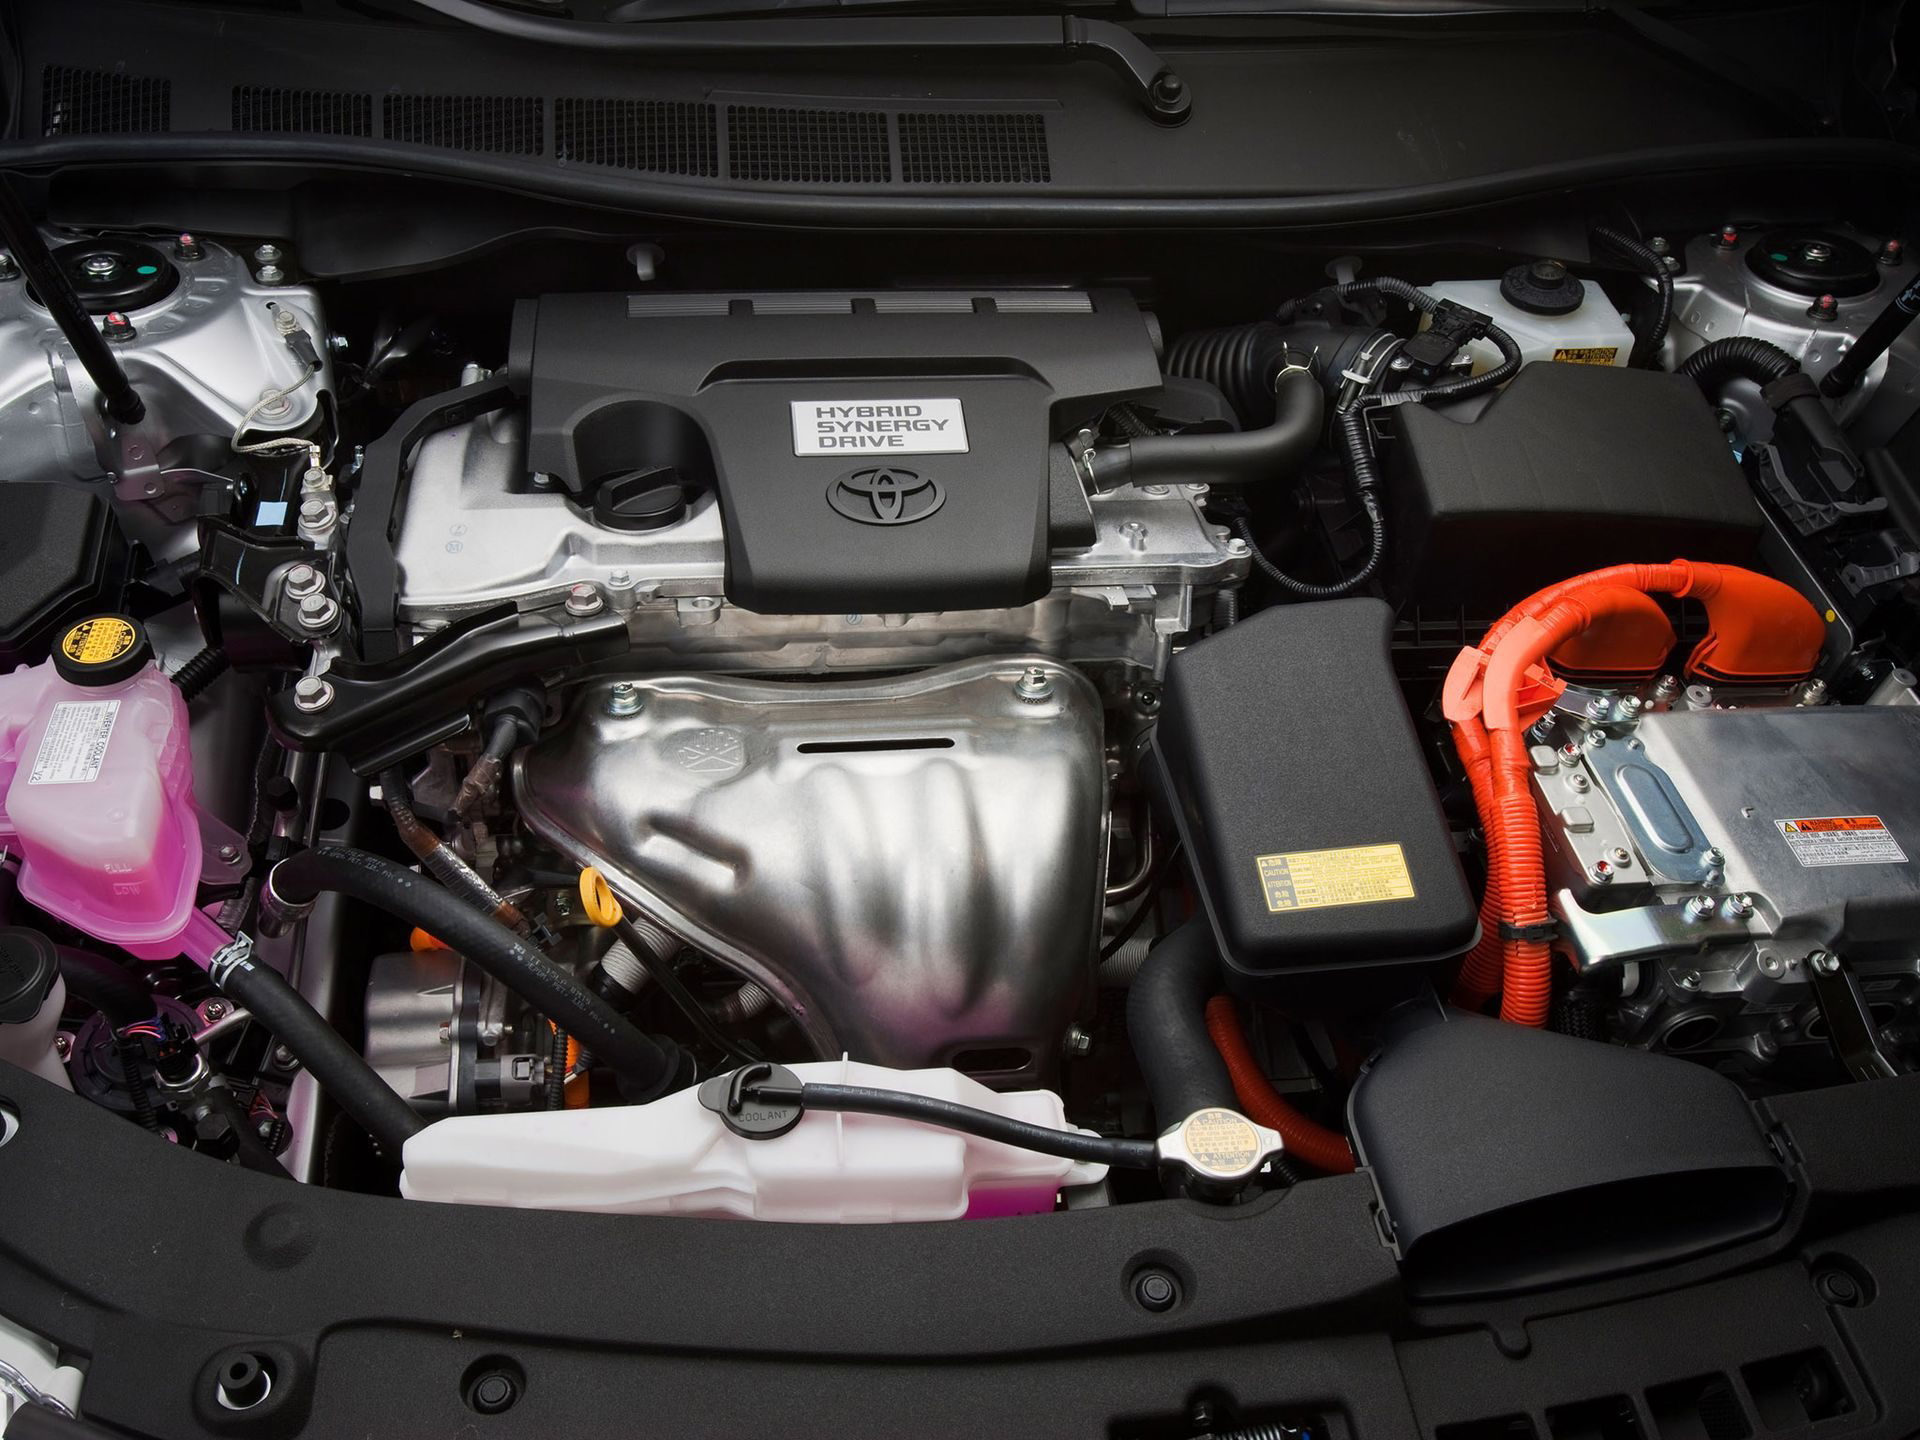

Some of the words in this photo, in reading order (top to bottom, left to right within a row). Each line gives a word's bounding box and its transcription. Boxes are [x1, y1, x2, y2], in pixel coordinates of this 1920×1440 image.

[816, 405, 922, 418] HYBRID
[817, 419, 950, 433] SYNERGY
[818, 435, 905, 448] DRIVE
[100, 711, 114, 739] INVERTER
[89, 741, 105, 769] COOLANT
[104, 864, 132, 874] FULL
[113, 884, 141, 896] LOW
[737, 1110, 788, 1122] COOLANT
